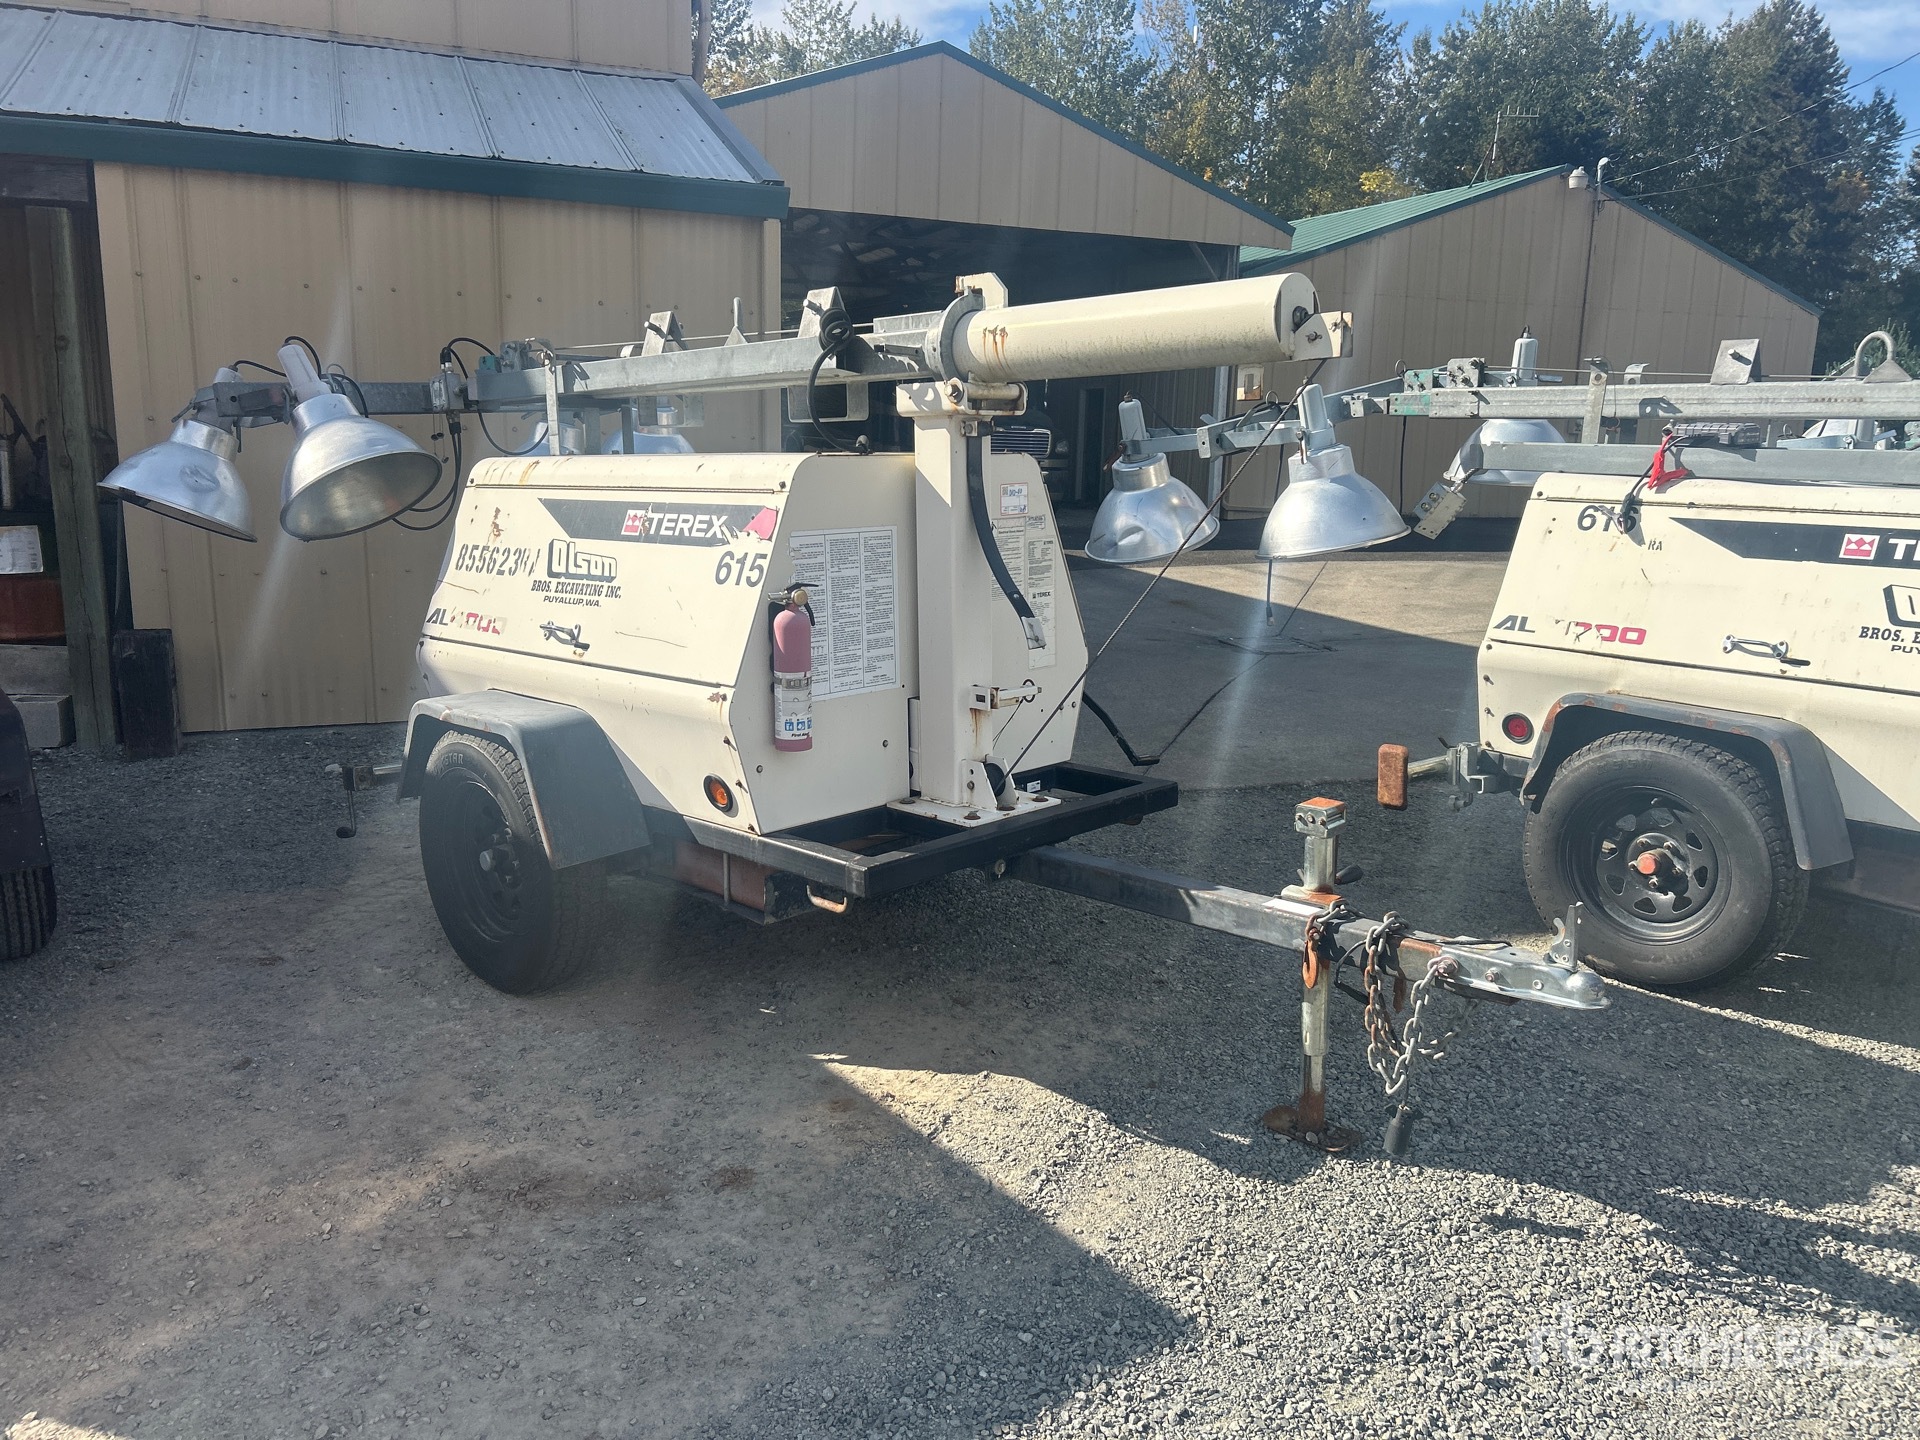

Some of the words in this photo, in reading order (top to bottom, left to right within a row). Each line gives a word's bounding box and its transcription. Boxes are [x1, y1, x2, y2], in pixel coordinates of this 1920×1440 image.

[649, 512, 728, 539] TEREX
[1888, 538, 1920, 561] T
[715, 550, 768, 588] 615
[531, 579, 552, 593] BROS.
[554, 581, 603, 597] EXCAVATING
[605, 585, 622, 599] INC.
[1859, 626, 1905, 643] BROS.
